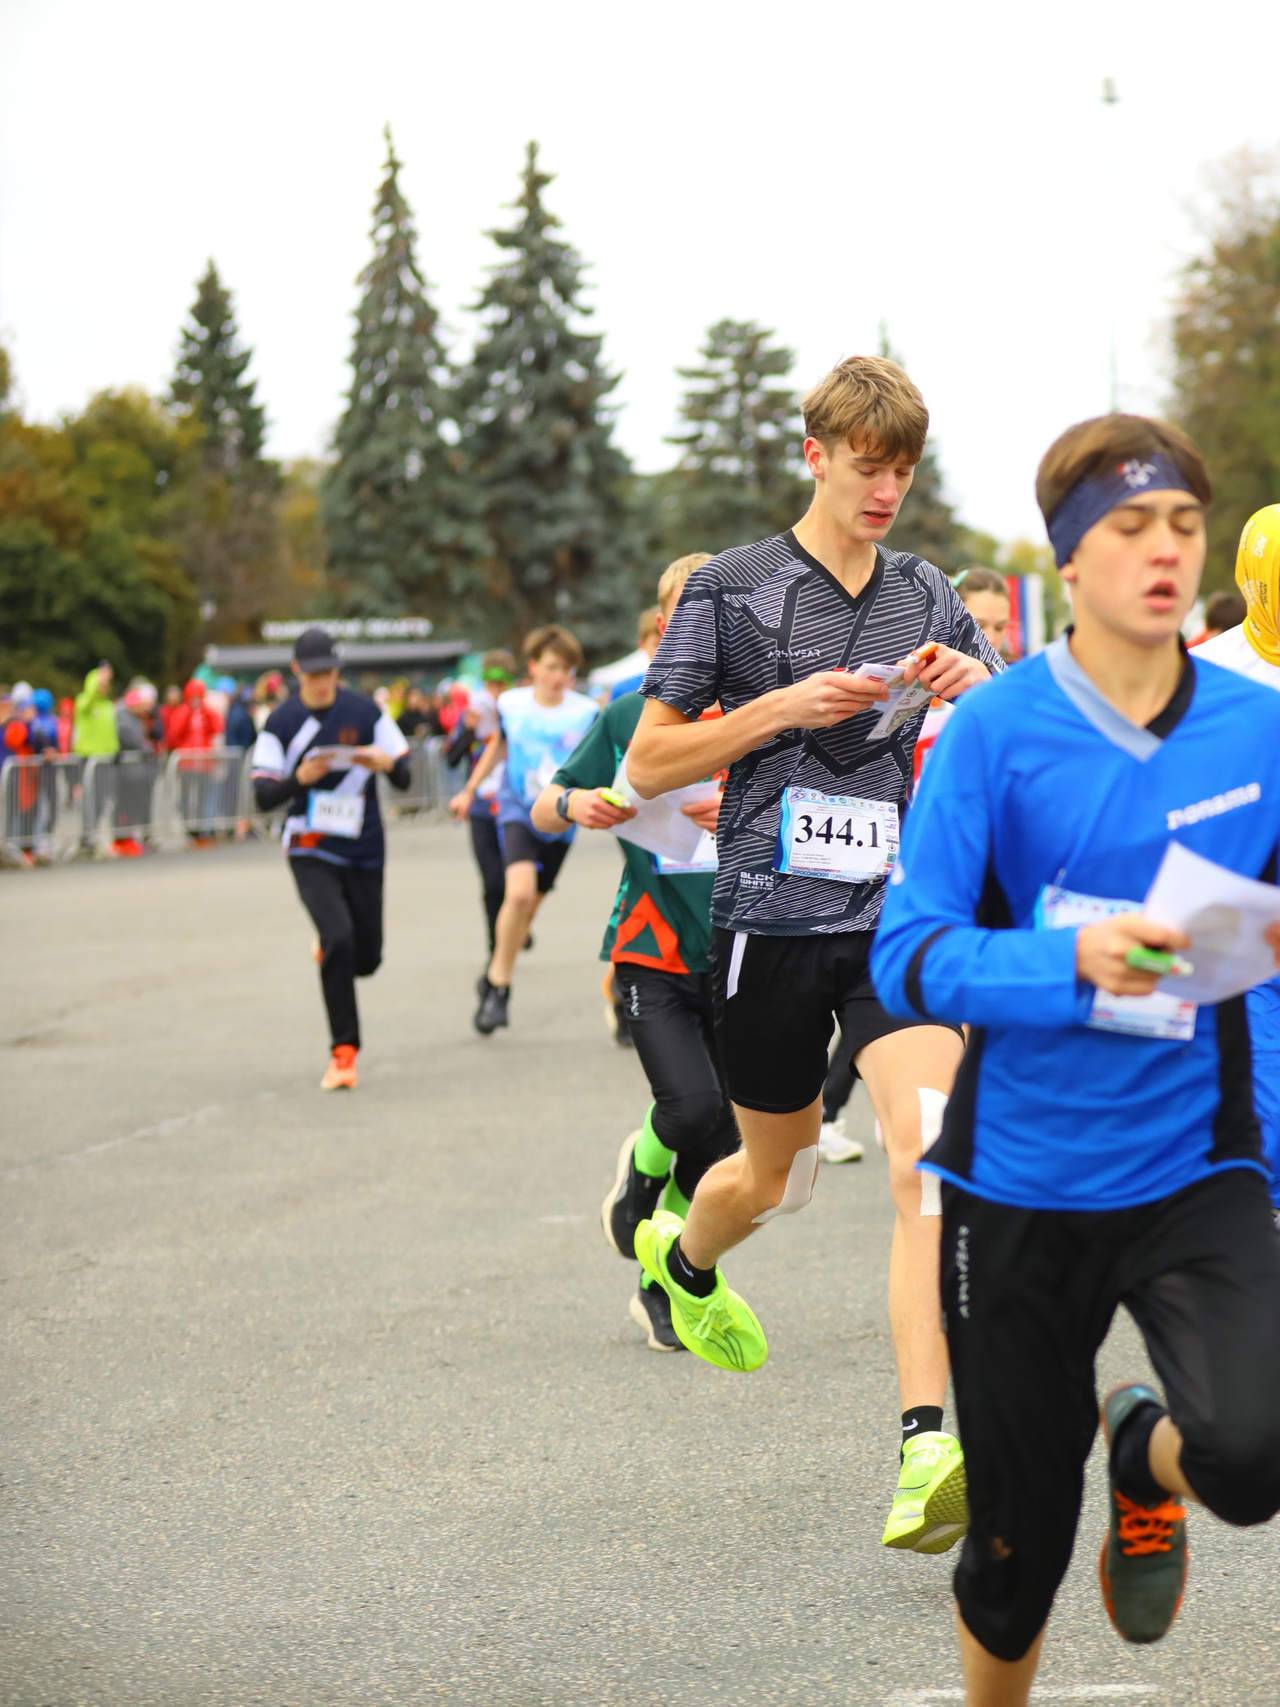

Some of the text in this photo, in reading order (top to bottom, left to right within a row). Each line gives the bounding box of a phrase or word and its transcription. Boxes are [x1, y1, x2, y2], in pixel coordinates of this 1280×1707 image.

[794, 814, 881, 848] 344.1
[740, 871, 775, 881] BLCK
[740, 878, 775, 888] WHITE
